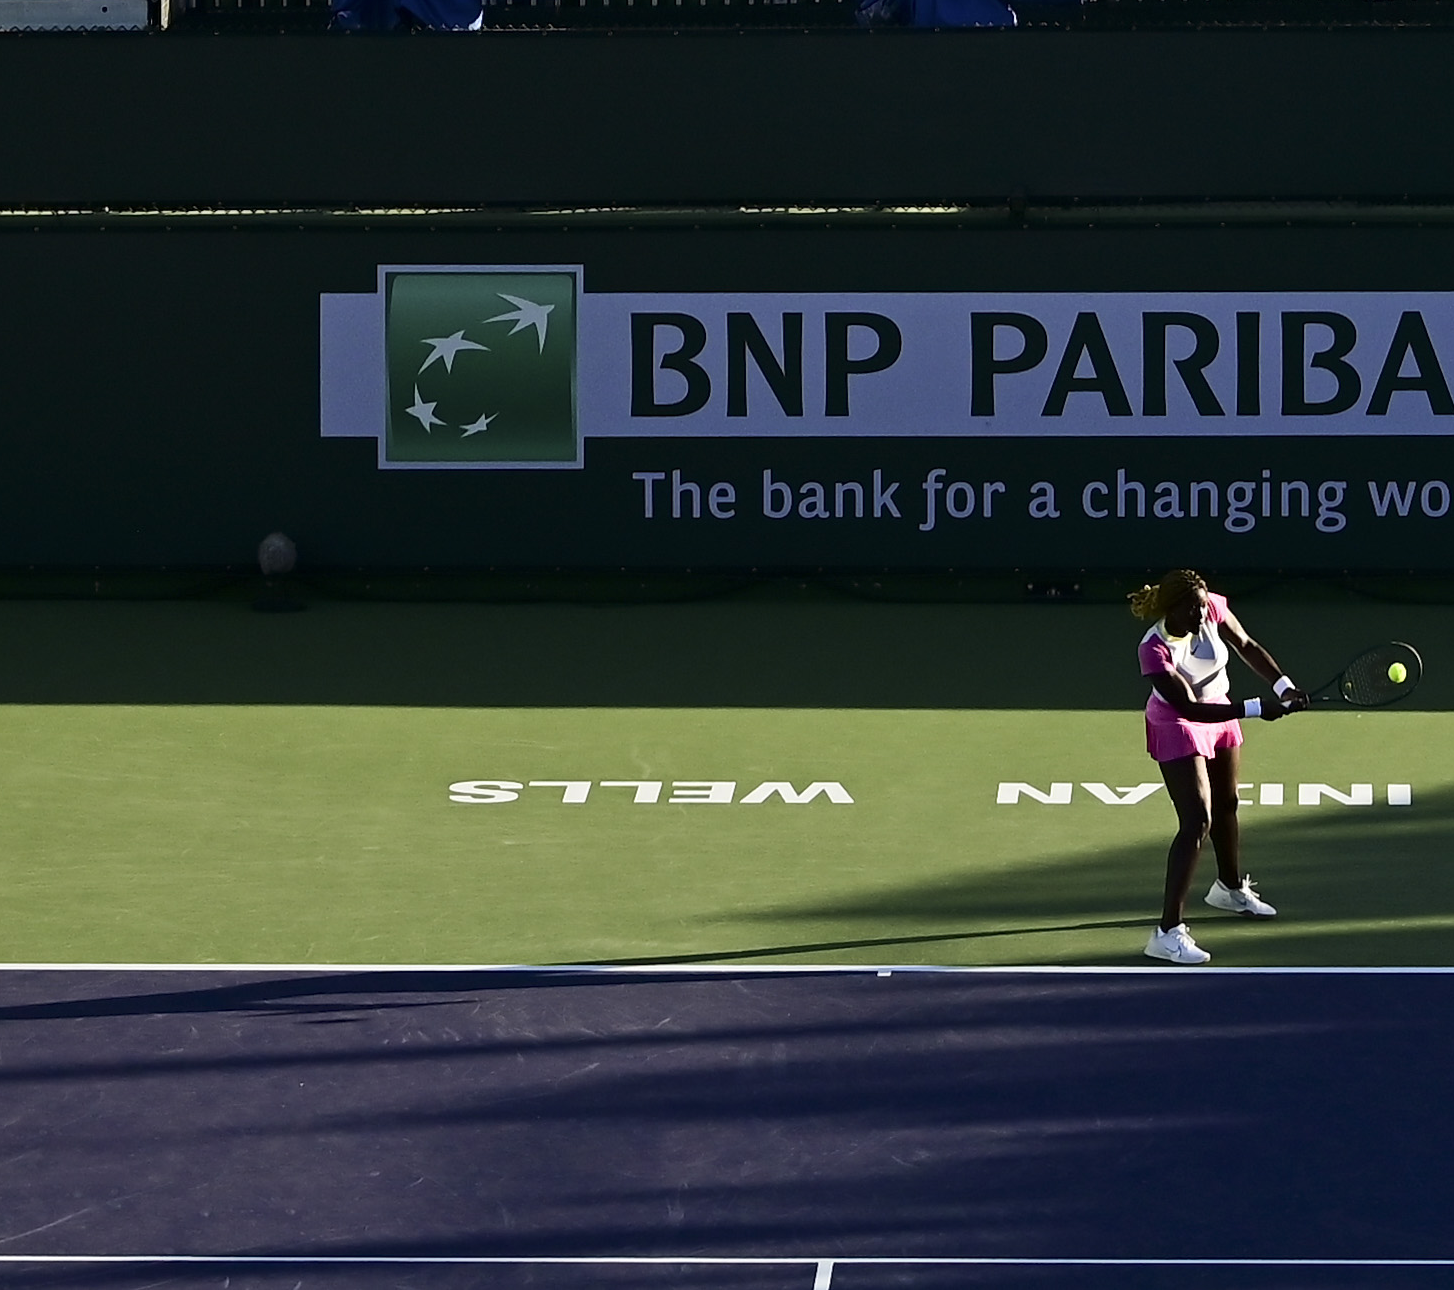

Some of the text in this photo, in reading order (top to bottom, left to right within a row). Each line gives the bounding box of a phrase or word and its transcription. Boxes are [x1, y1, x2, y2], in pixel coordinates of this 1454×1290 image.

[630, 311, 903, 418] BNP
[632, 469, 736, 519] The
[763, 468, 902, 519] bank
[919, 468, 1006, 531] for
[1028, 481, 1061, 519] a
[1082, 468, 1347, 533] changing
[447, 780, 855, 805] WELLS
